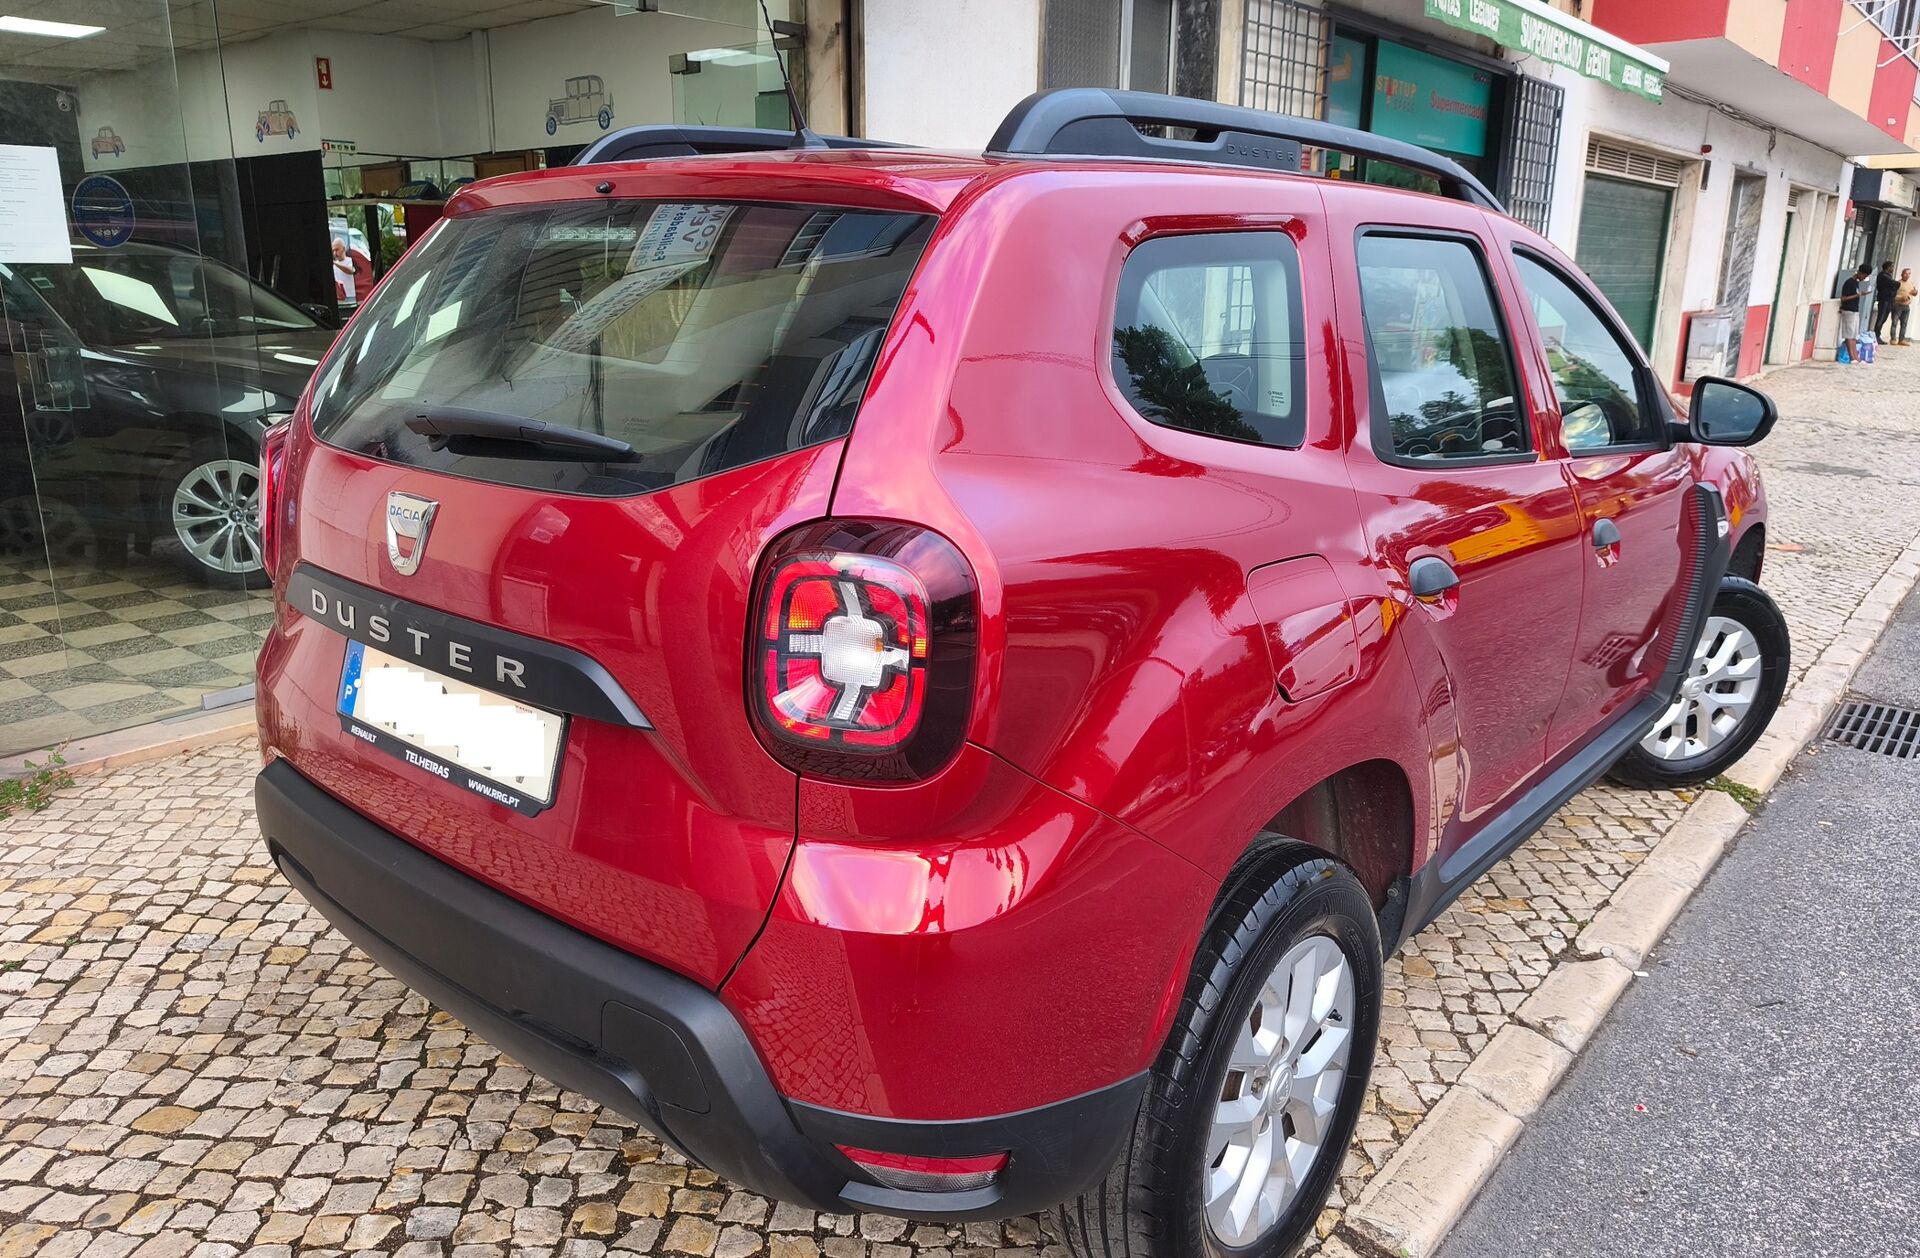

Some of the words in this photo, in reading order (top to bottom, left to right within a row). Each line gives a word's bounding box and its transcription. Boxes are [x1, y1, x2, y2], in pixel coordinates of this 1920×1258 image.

[1520, 13, 1583, 70] SUPERMERCADO
[1585, 43, 1612, 81] GENTIL
[1226, 143, 1295, 161] DUSTER
[389, 505, 420, 521] DACIA
[311, 588, 526, 688] DUSTER
[344, 684, 353, 699] P
[350, 725, 377, 743] RENAULT
[405, 750, 450, 779] TELHEIRAS
[468, 779, 520, 807] WWW.RRG.PT
